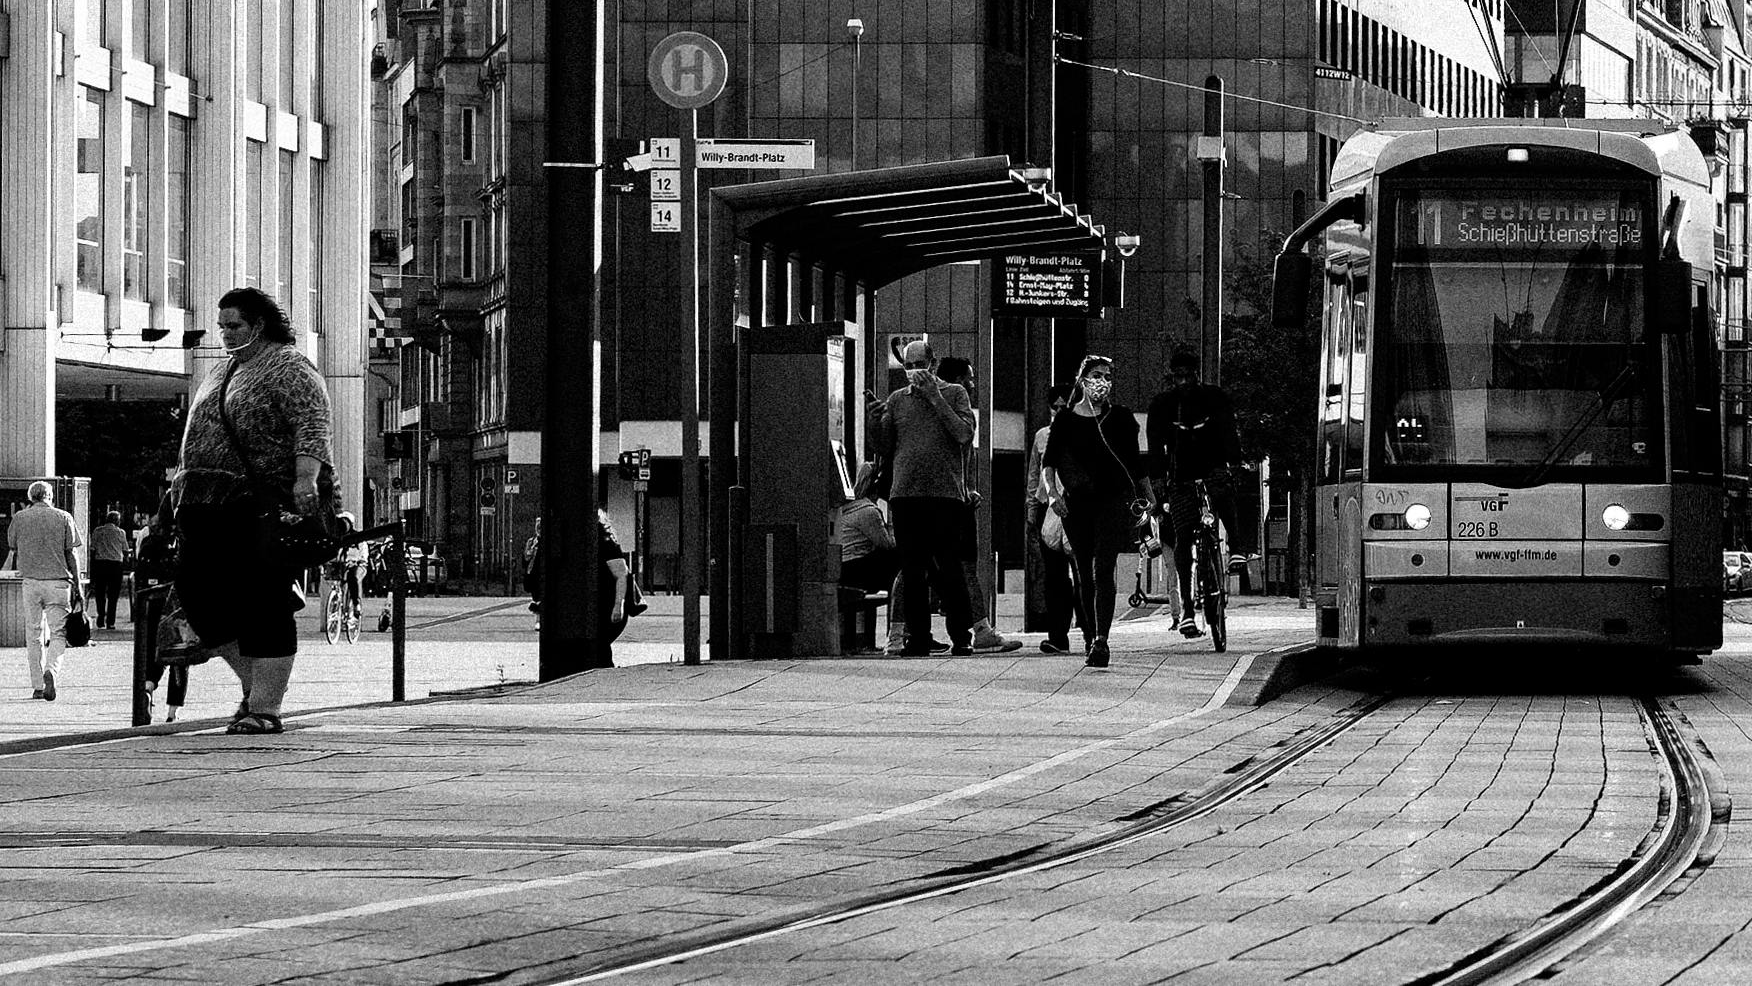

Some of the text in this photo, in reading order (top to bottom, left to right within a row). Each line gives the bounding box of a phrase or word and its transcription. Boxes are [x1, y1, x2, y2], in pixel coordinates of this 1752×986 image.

[671, 48, 704, 92] H
[656, 146, 670, 158] 11
[701, 151, 786, 164] Willy-Brandt-Platz
[656, 178, 671, 191] 12
[656, 210, 672, 222] 14
[1410, 198, 1442, 245] 11
[1457, 222, 1642, 246] Schießhüttenstraße
[1005, 255, 1083, 267] Willy-Brandt-Platz
[507, 470, 517, 483] P
[1481, 500, 1509, 512] VGF
[1458, 522, 1499, 537] 226 B
[1475, 549, 1557, 561] www.vgf-ffm.de
